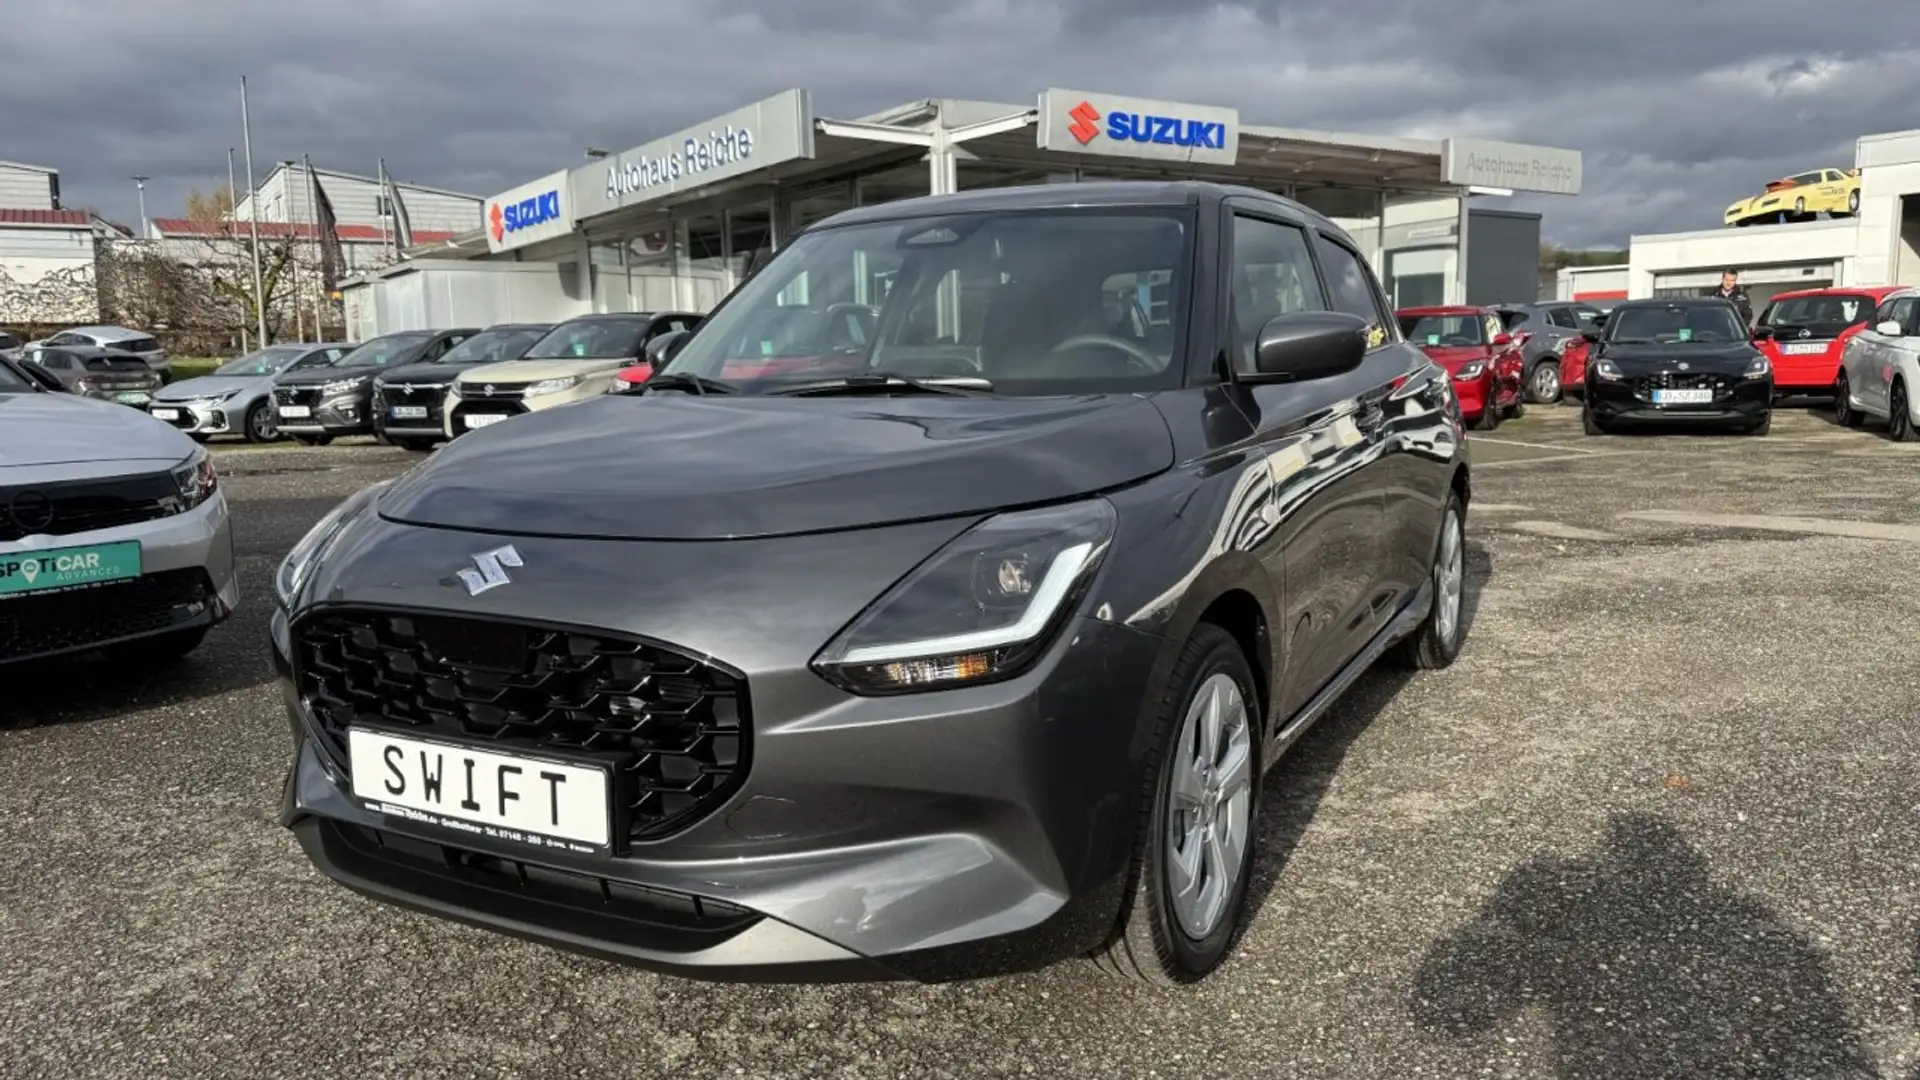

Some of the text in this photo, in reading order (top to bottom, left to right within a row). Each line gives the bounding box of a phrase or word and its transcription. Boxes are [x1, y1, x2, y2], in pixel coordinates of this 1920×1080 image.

[1106, 111, 1226, 149] SUZUKI
[606, 126, 753, 198] Autohaus Reiche
[1466, 152, 1529, 176] Autohaus
[504, 190, 560, 233] SUZUKI
[56, 565, 121, 582] ADVANCED
[383, 745, 567, 827] SWIFT
